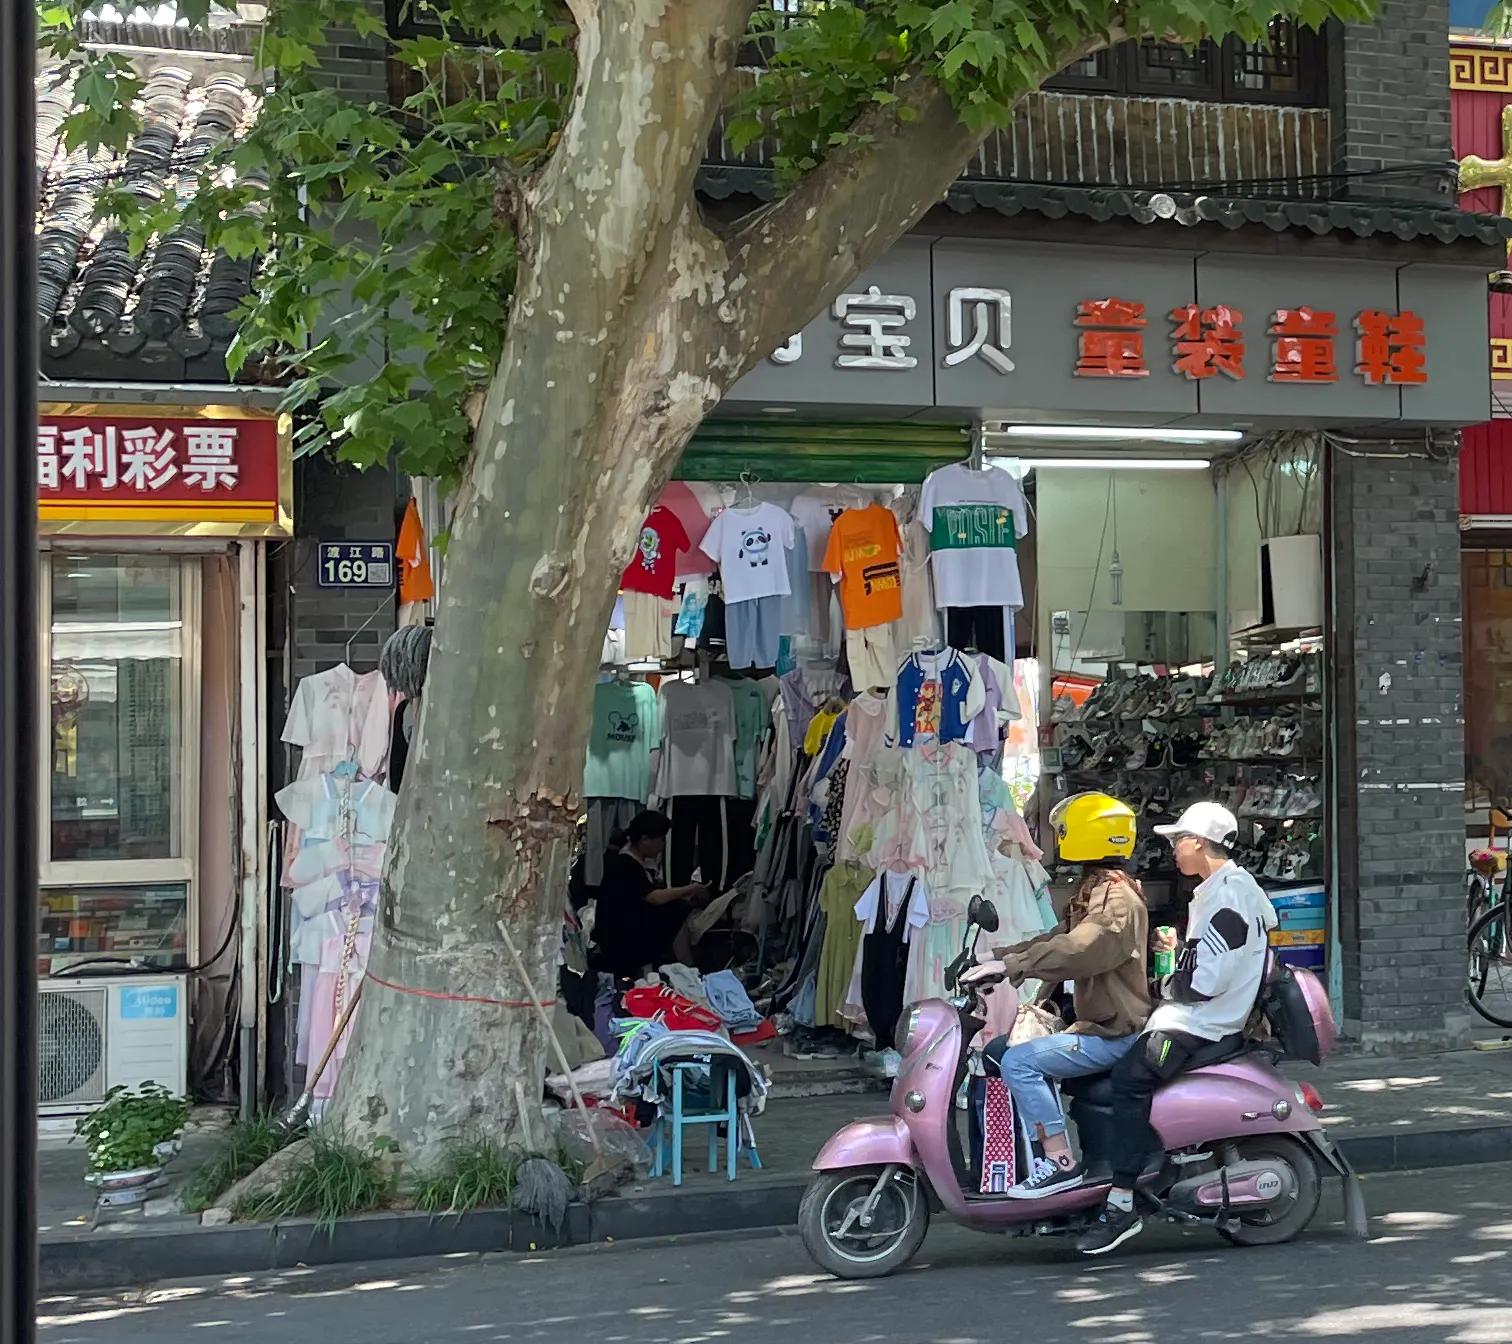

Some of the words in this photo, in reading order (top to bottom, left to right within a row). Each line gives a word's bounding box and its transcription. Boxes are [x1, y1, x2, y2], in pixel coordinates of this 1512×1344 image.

[771, 285, 1016, 375] 宝贝
[1073, 296, 1429, 386] 童装童鞋
[324, 559, 367, 583] 169
